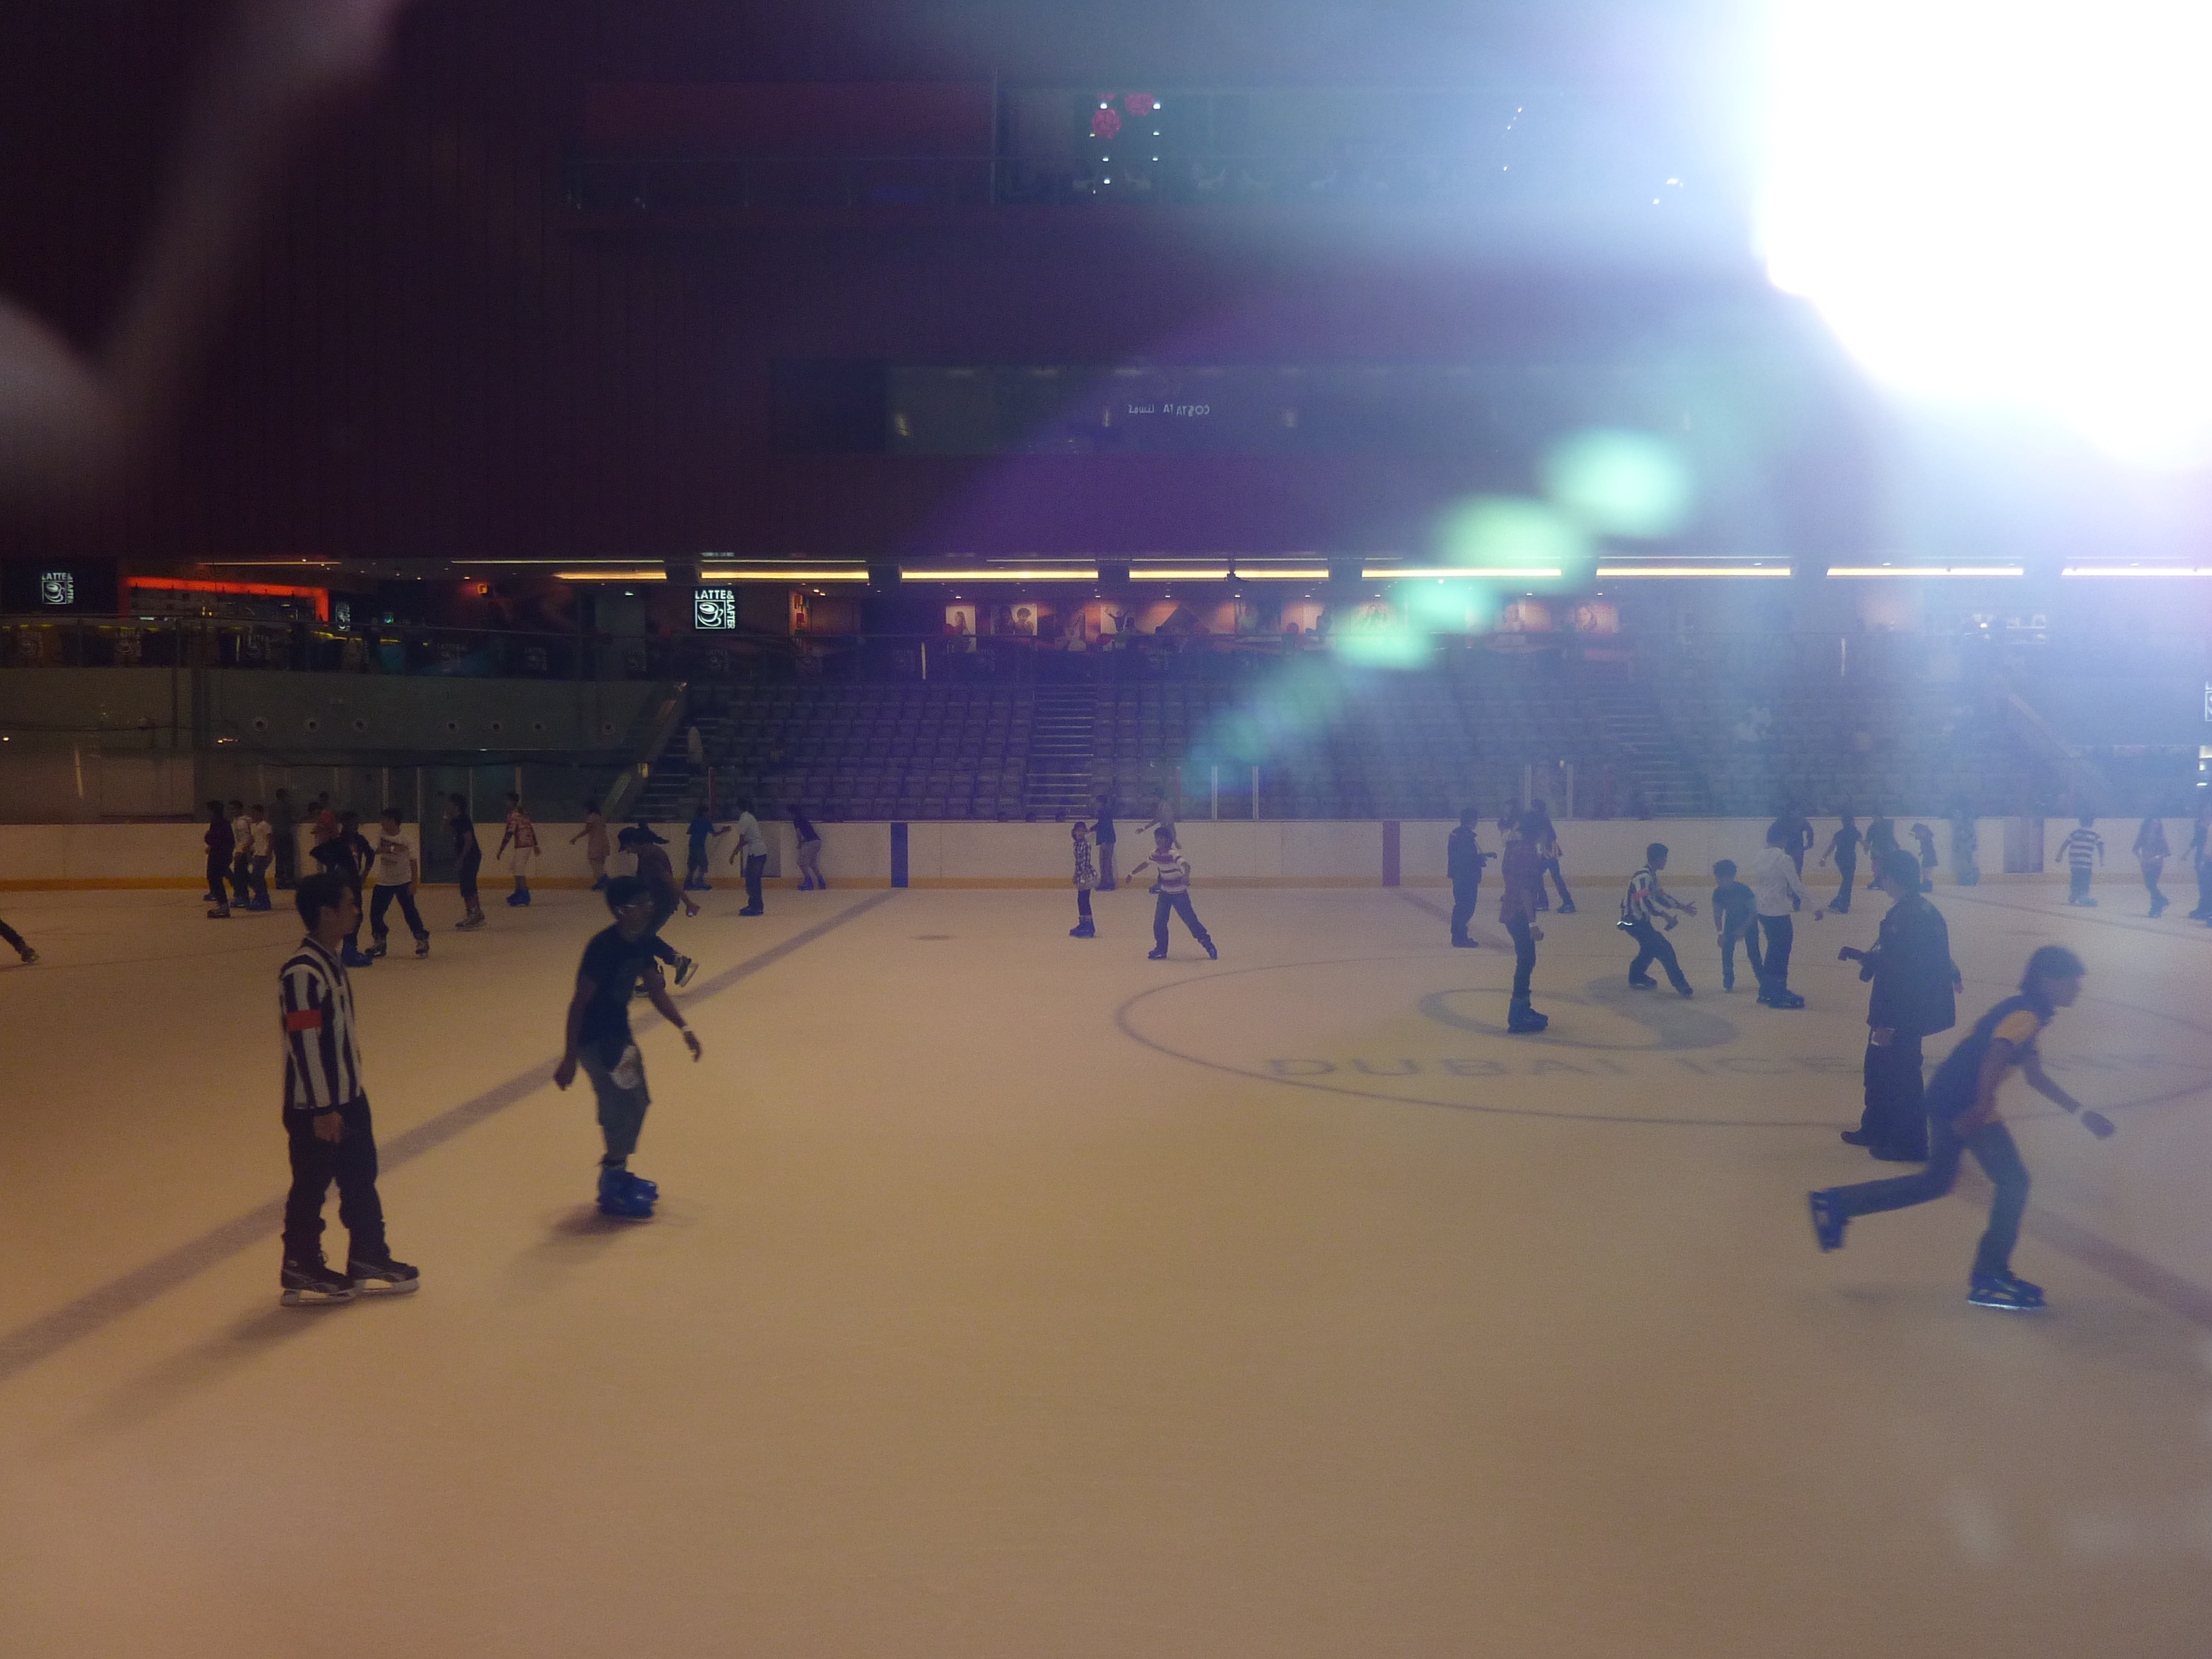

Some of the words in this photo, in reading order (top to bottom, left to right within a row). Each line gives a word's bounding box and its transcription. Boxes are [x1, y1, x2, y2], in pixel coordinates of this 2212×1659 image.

[726, 599, 736, 629] LAFTER
[1268, 1057, 1629, 1077] DUBAI
[1674, 1054, 1864, 1076] ICE
